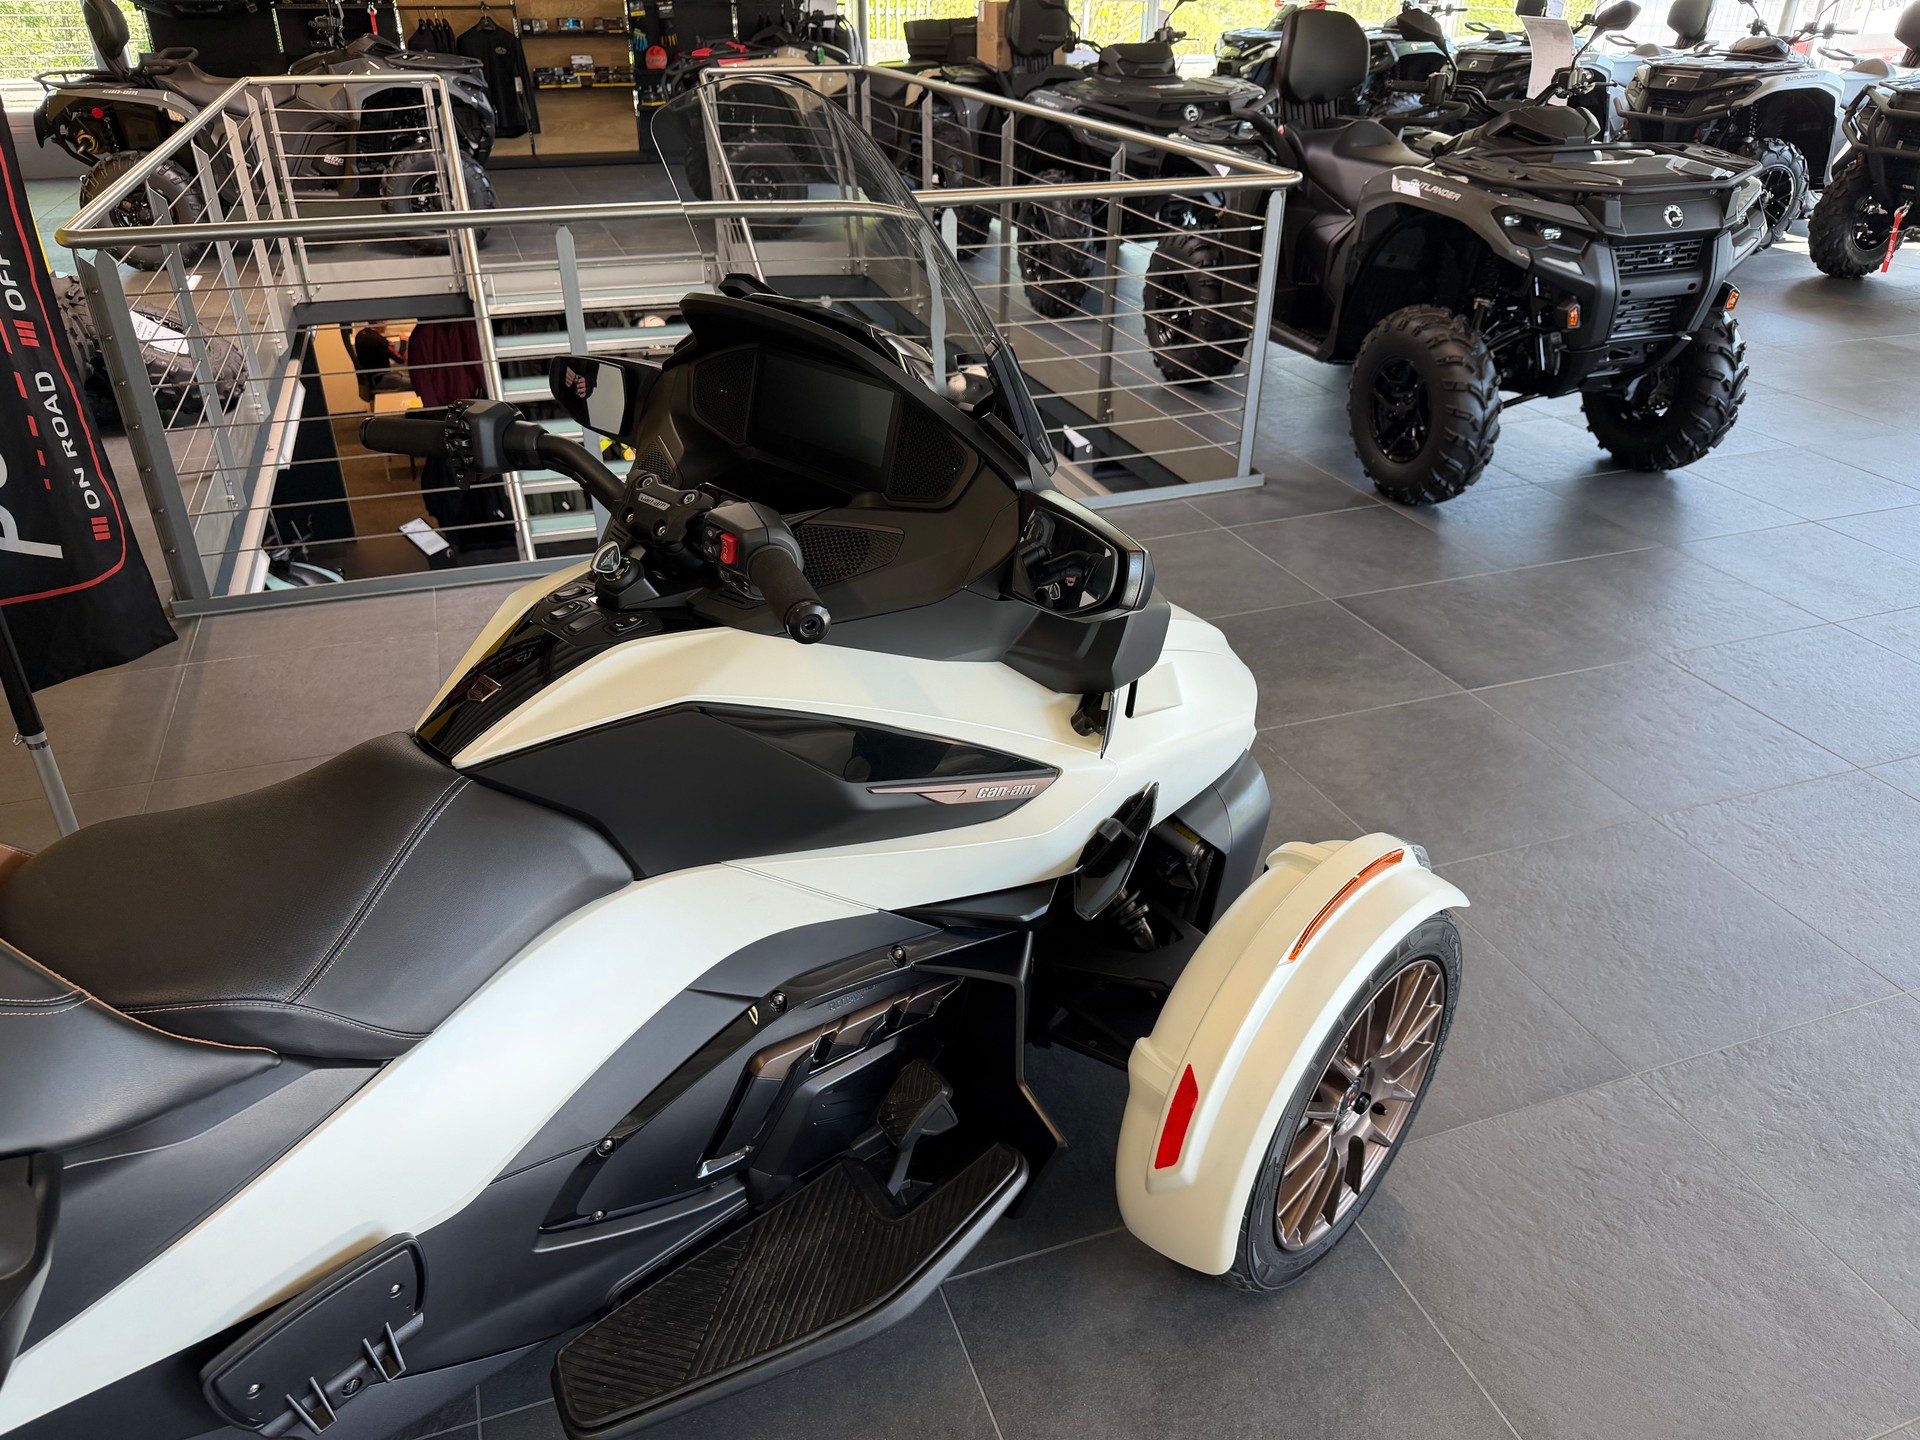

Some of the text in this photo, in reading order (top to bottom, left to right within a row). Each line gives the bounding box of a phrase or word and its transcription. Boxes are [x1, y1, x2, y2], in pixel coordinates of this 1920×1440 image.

[34, 371, 101, 510] ON ROAD
[976, 784, 1037, 799] can-am
